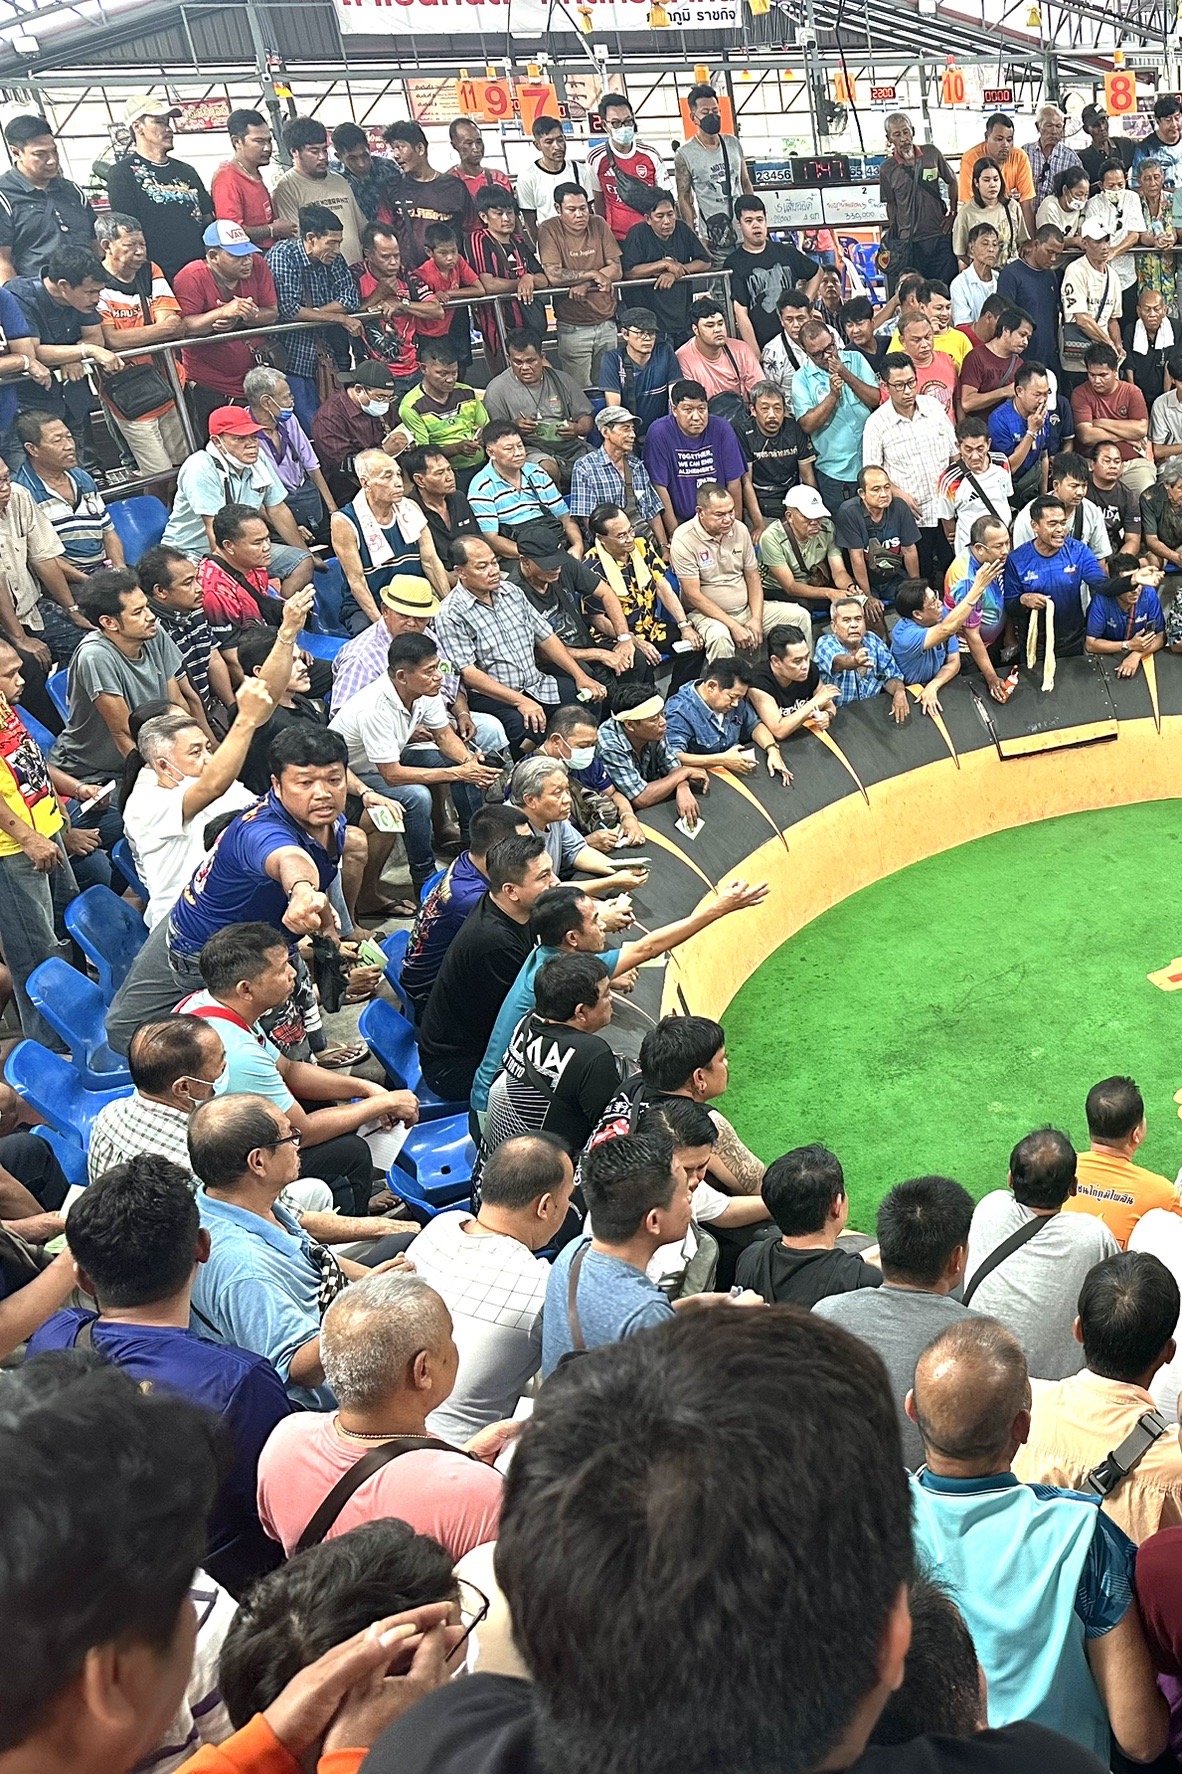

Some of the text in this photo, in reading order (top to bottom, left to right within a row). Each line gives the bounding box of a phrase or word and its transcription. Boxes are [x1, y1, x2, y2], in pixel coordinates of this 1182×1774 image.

[697, 10, 736, 22] ราชกิจ
[872, 87, 894, 99] 2200
[943, 74, 964, 101] 10
[985, 90, 1010, 102] 0000
[1111, 76, 1132, 110] 8
[460, 85, 478, 110] 11
[485, 87, 507, 116] 9
[522, 90, 549, 121] 7
[756, 169, 792, 181] 23456
[678, 449, 713, 459] TOGETHER,
[701, 458, 714, 466] END
[505, 1056, 526, 1079] TOKYO
